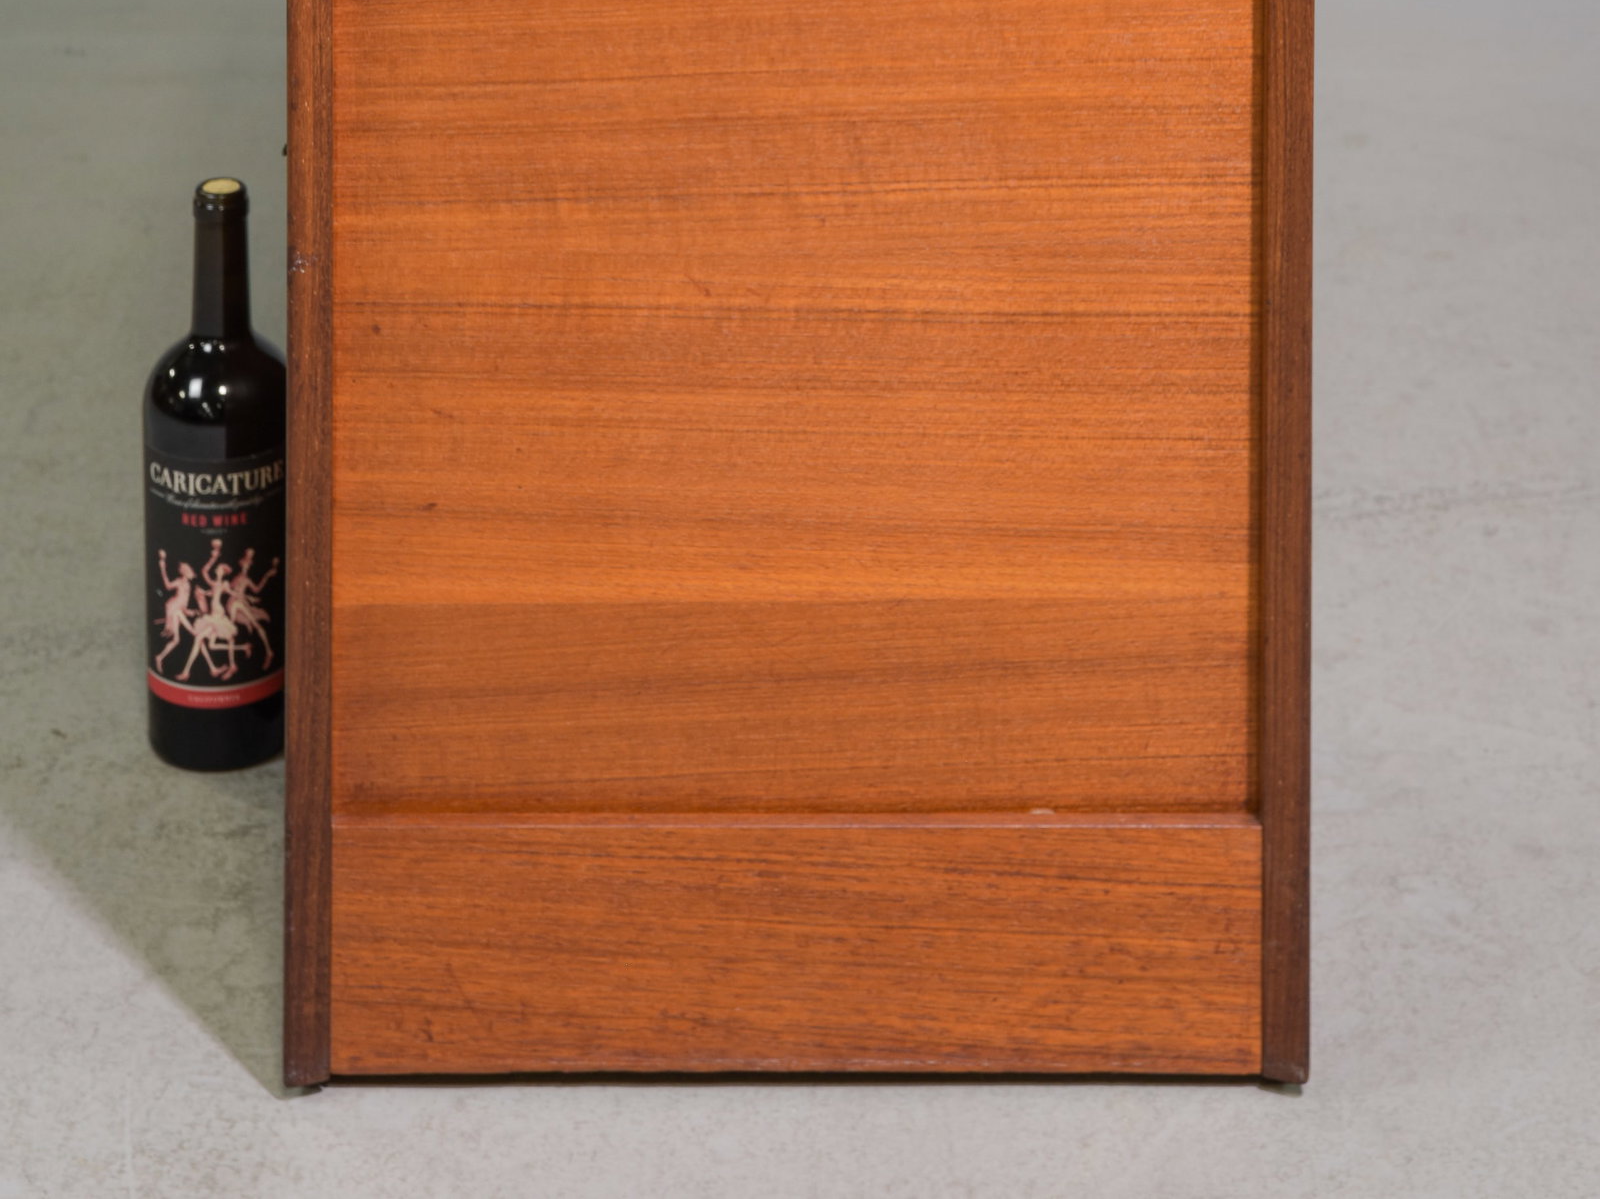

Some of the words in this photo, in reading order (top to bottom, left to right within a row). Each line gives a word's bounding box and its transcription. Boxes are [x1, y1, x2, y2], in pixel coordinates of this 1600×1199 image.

[149, 461, 284, 496] CARICATURE
[181, 511, 208, 527] RED
[212, 512, 248, 527] WINE
